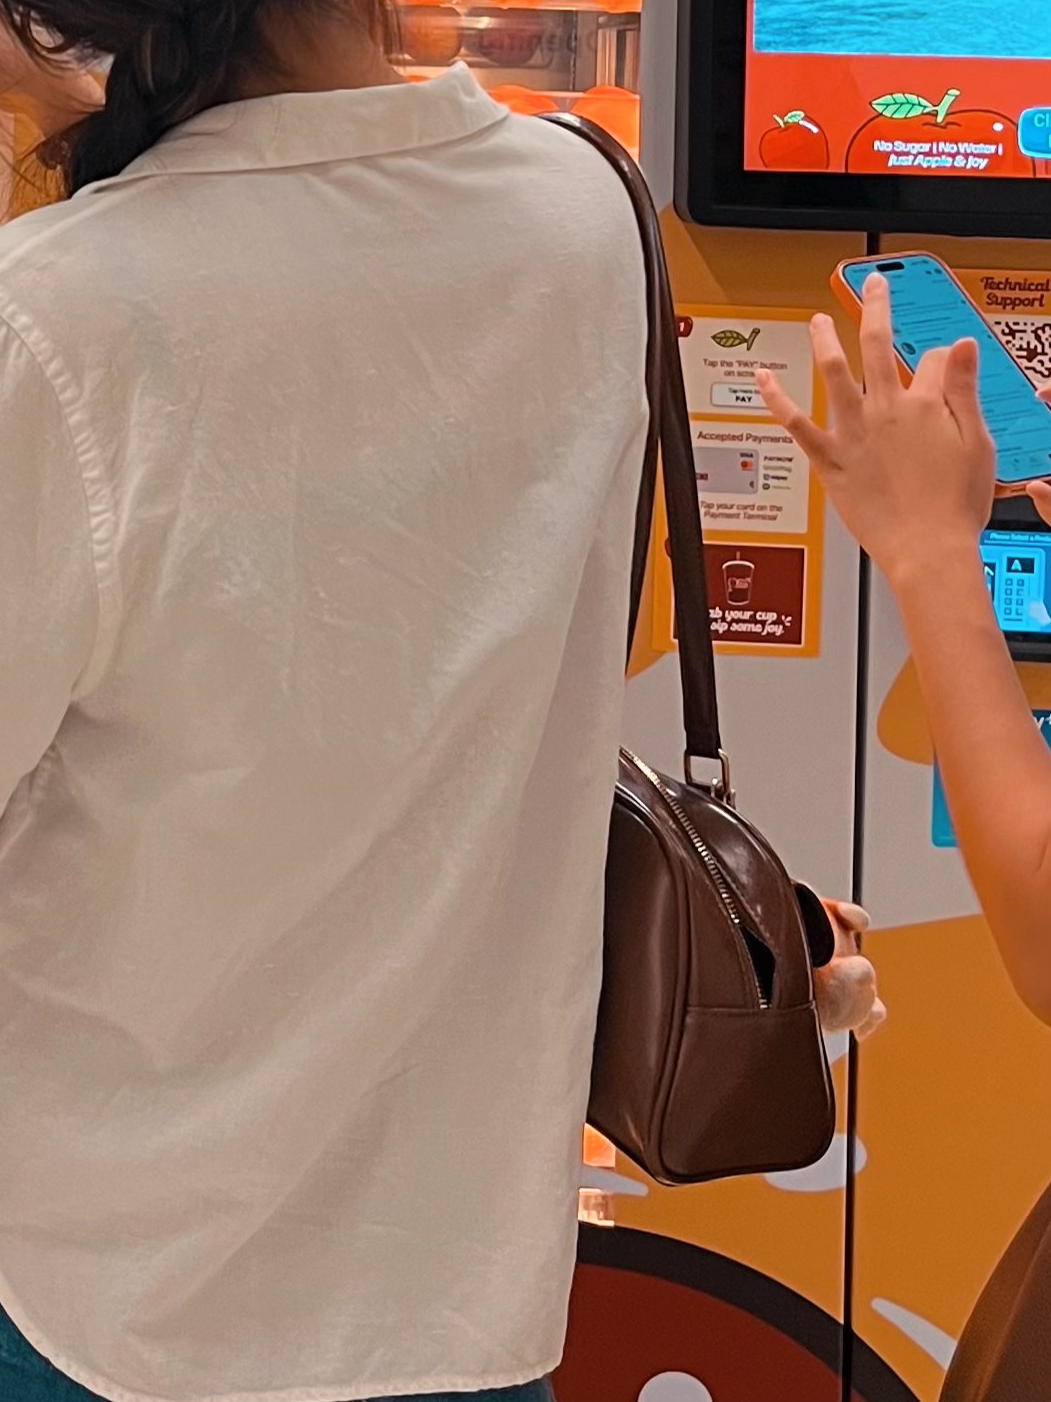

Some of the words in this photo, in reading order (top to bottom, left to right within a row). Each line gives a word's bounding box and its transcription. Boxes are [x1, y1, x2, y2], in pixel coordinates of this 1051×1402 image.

[873, 140, 893, 152] No
[893, 141, 932, 153] Sugar
[939, 142, 958, 153] No
[958, 143, 998, 154] Water
[914, 155, 952, 169] Apple
[980, 276, 1051, 291] Technical
[986, 292, 1045, 310] Support
[703, 358, 717, 368] Tap
[720, 359, 733, 367] the
[759, 361, 788, 370] button
[735, 395, 753, 403] PAY
[697, 431, 744, 443] Accepted
[745, 433, 794, 444] Payments
[700, 501, 715, 511] Tap
[716, 503, 735, 511] your
[704, 511, 741, 519] Payment
[743, 512, 779, 521] Terminal
[724, 609, 754, 622] your
[755, 611, 778, 622] cup
[710, 619, 729, 634] sip
[729, 623, 763, 632] some
